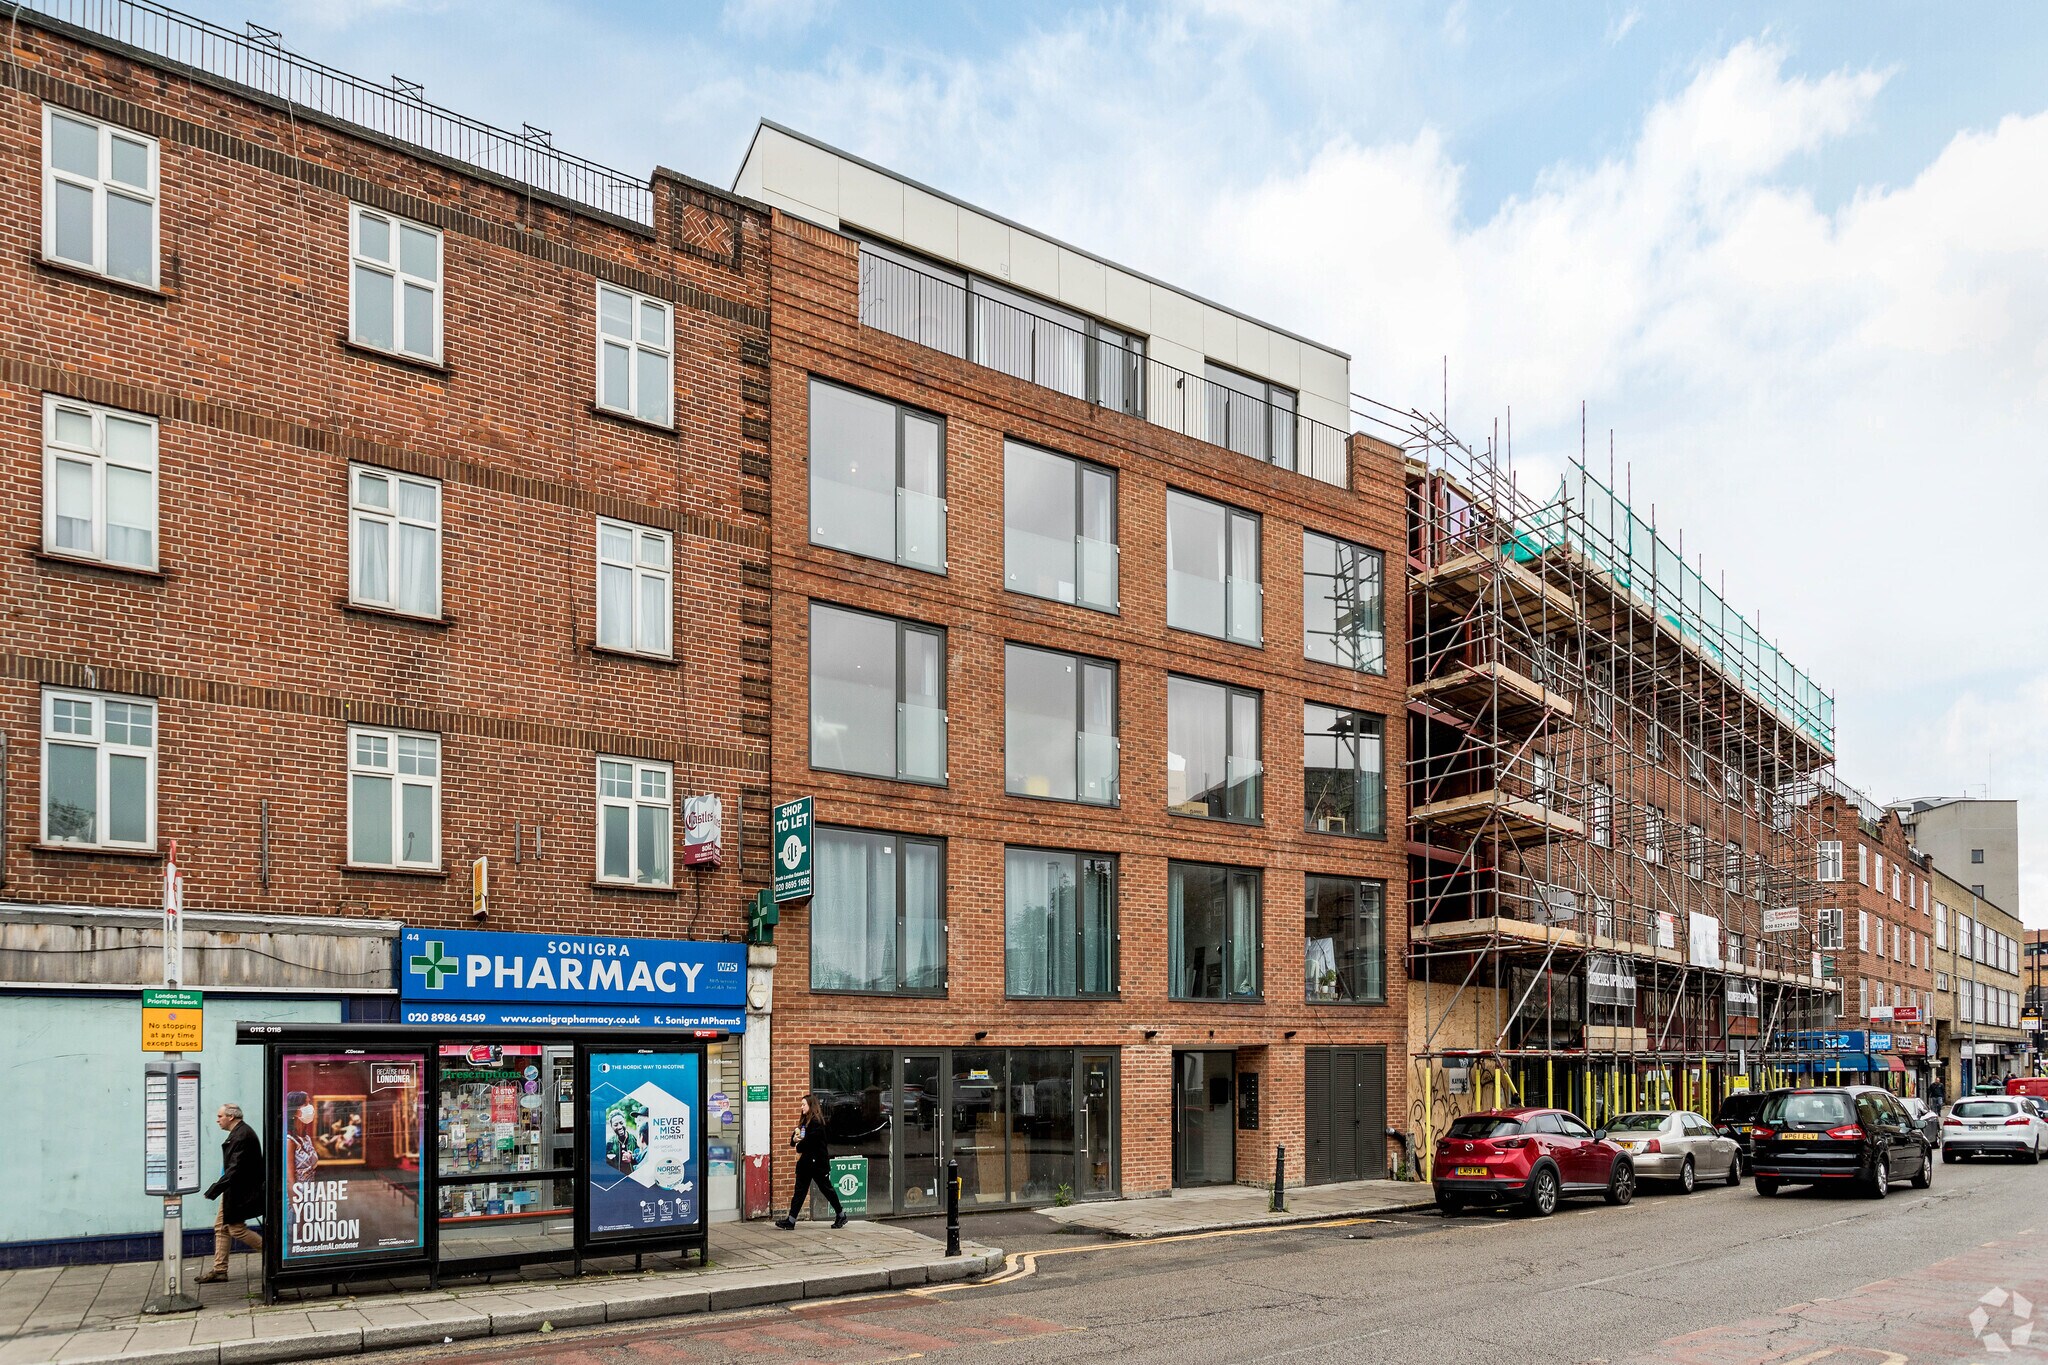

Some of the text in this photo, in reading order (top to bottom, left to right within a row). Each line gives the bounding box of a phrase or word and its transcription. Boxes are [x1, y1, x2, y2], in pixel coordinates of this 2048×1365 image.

[782, 803, 803, 817] SHOP
[776, 813, 809, 833] TO LET
[406, 933, 420, 942] 44
[547, 941, 631, 957] SONIGRA
[466, 954, 705, 993] PHARMACY
[718, 962, 738, 972] NHS
[407, 1012, 741, 1027] 020 8986 4549 www.sonigrapharmacy.co.uk K. Sonigra MPharmS
[376, 1074, 411, 1084] LONDONER
[443, 1070, 522, 1081] Prescriptions
[653, 1117, 685, 1126] NEVER
[660, 1126, 681, 1135] MISS
[656, 1165, 682, 1173] NORDIC
[292, 1180, 348, 1203] SHARE
[292, 1201, 338, 1224] YOUR
[292, 1219, 360, 1244] LONDON
